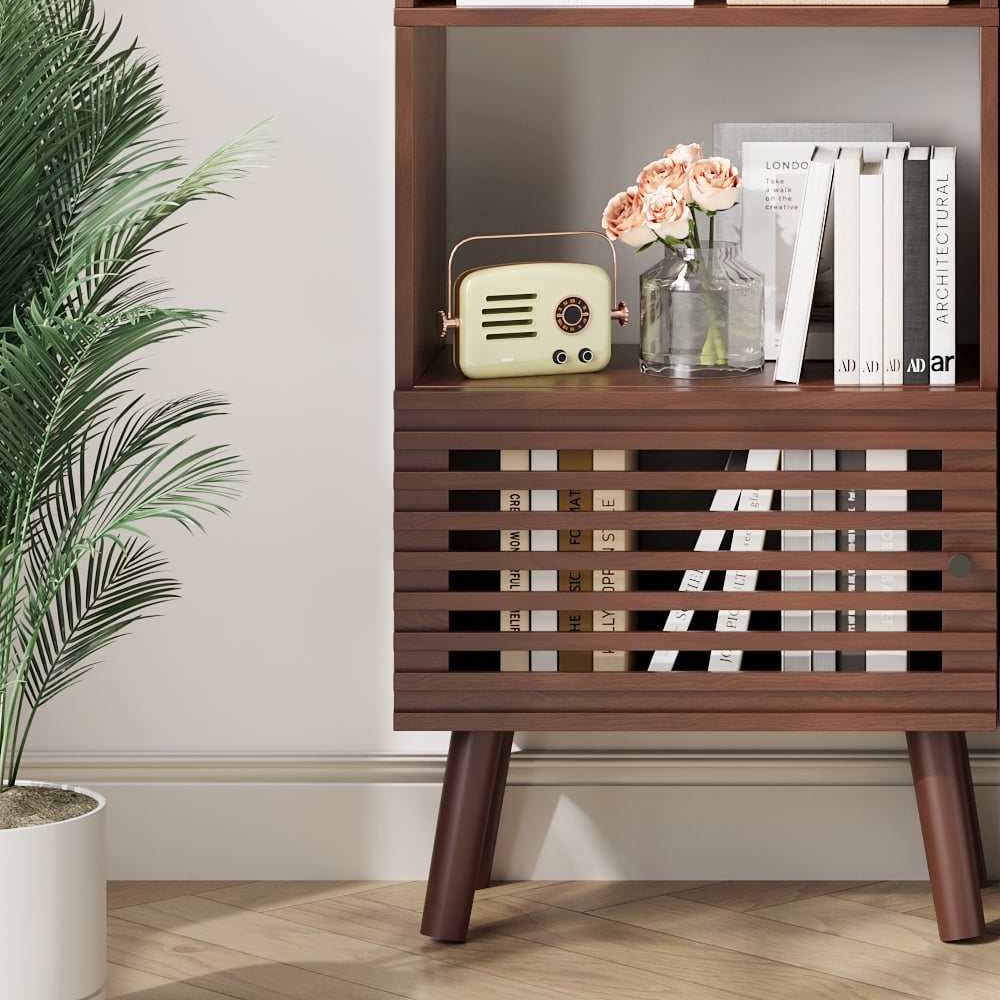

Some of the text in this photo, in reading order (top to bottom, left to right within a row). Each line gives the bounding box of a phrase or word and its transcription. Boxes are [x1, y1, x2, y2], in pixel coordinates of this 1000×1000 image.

[766, 161, 809, 170] LONDO
[936, 174, 950, 325] ARCHITECTURAL
[838, 359, 856, 373] AD
[862, 360, 879, 373] AD
[886, 358, 901, 372] AD
[907, 358, 926, 373] AD
[931, 354, 955, 372] ar
[569, 572, 581, 592] SIC
[569, 615, 581, 632] HE
